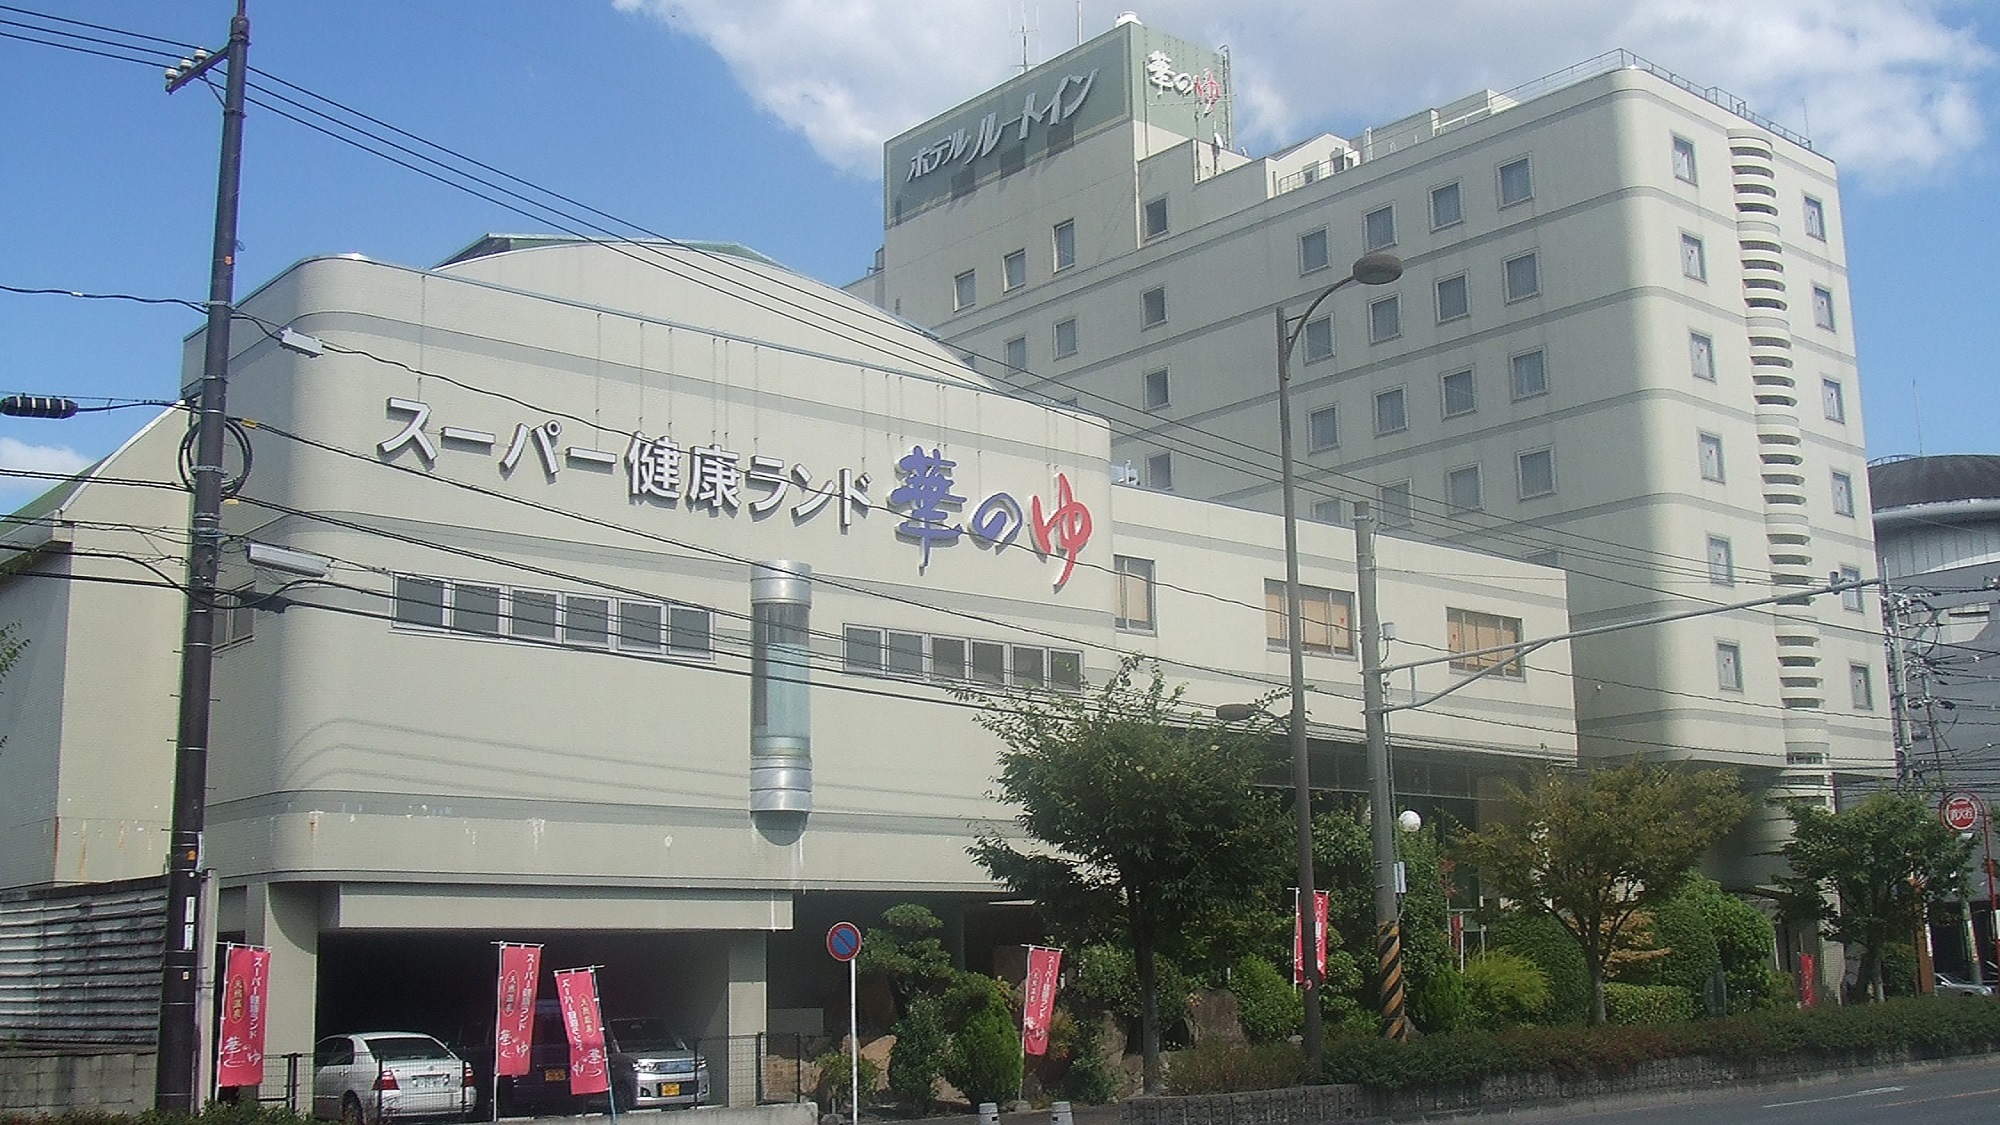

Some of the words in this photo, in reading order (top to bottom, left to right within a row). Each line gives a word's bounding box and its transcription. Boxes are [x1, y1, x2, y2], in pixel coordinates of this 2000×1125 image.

[1146, 50, 1221, 117] 華のゆ
[377, 397, 872, 531] スーパー健康ランド
[887, 445, 1093, 592] 華のゆ
